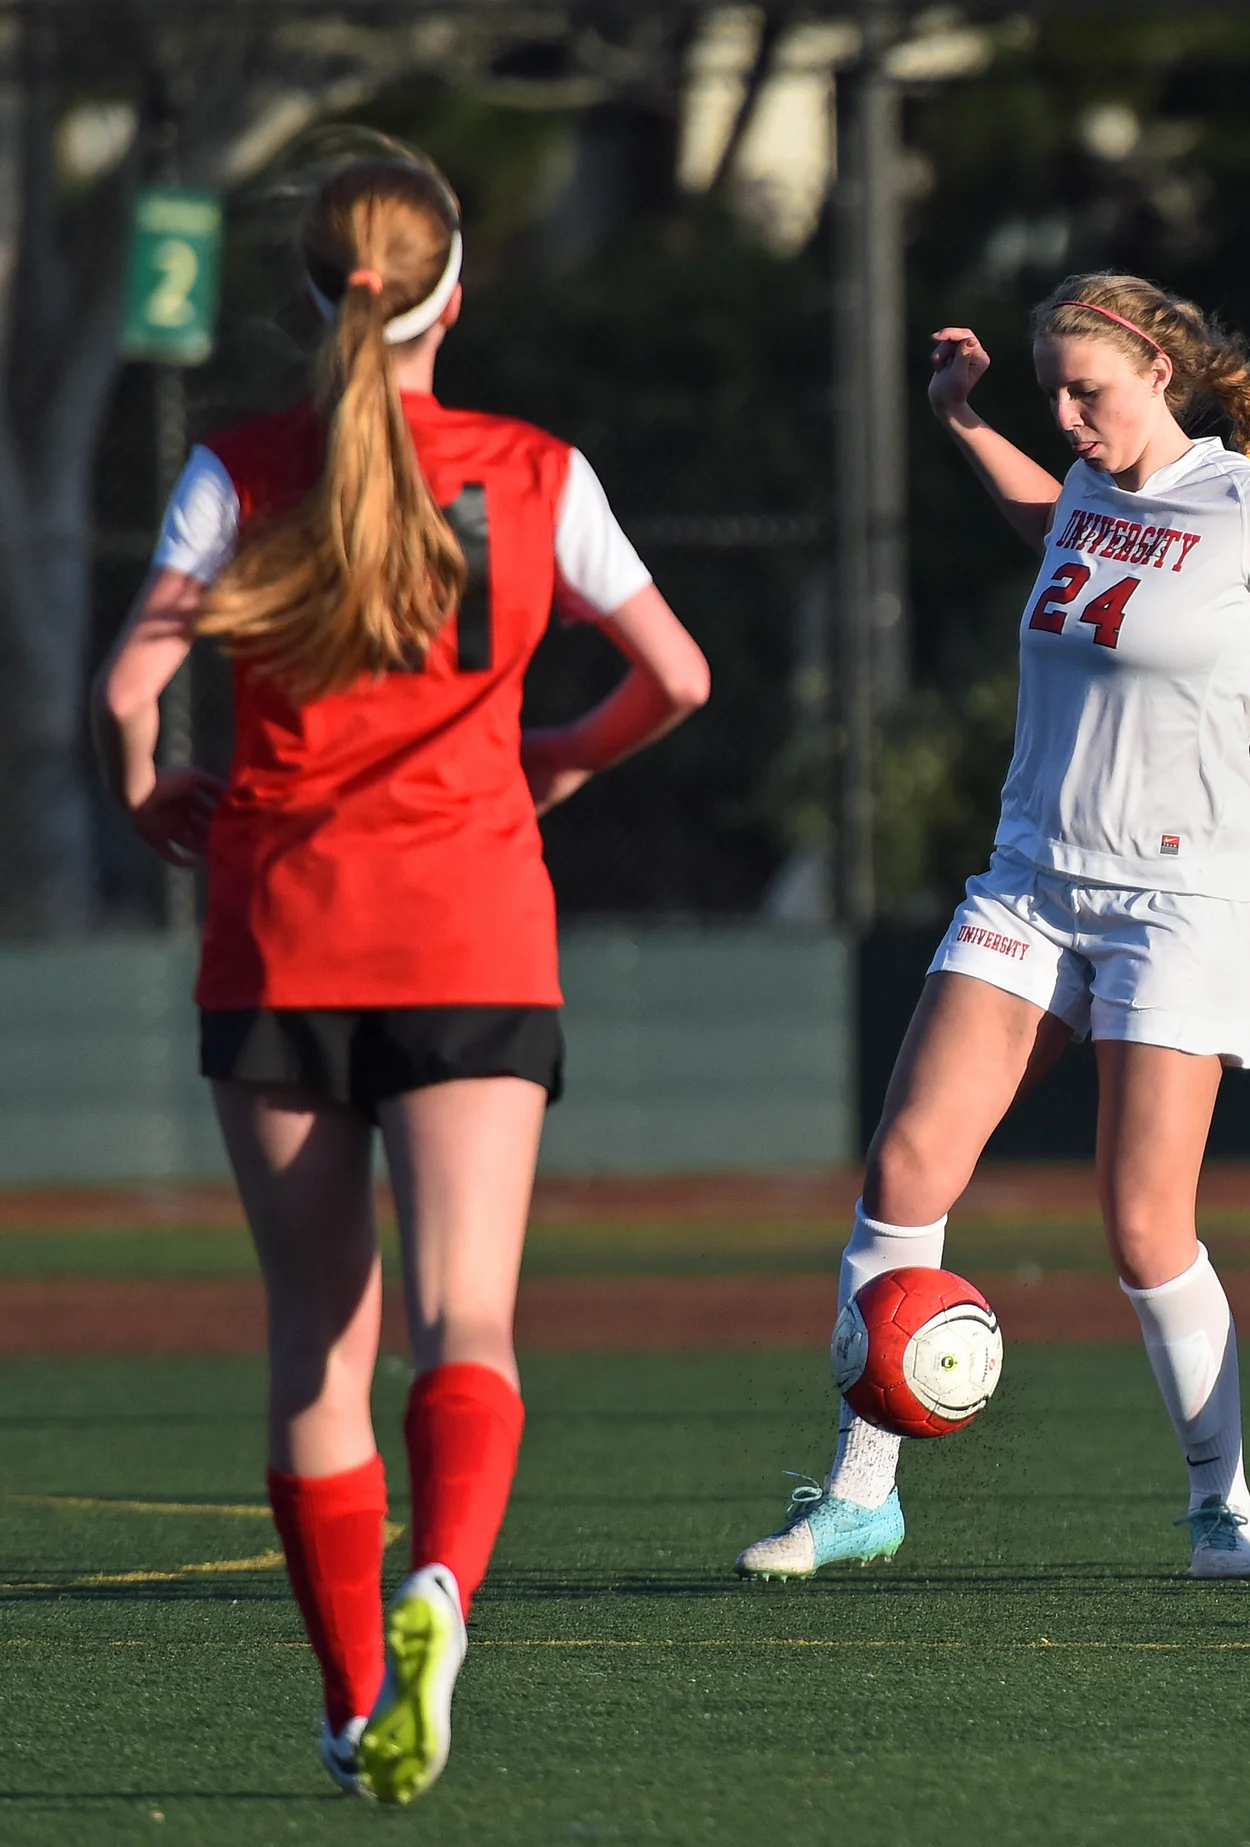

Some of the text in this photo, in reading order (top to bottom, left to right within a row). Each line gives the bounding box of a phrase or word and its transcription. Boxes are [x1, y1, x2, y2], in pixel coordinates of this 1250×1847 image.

[146, 240, 199, 327] 2
[1056, 509, 1201, 572] UNIVERSITY
[1028, 562, 1142, 649] 24
[957, 925, 1030, 960] UNIVERSITY
